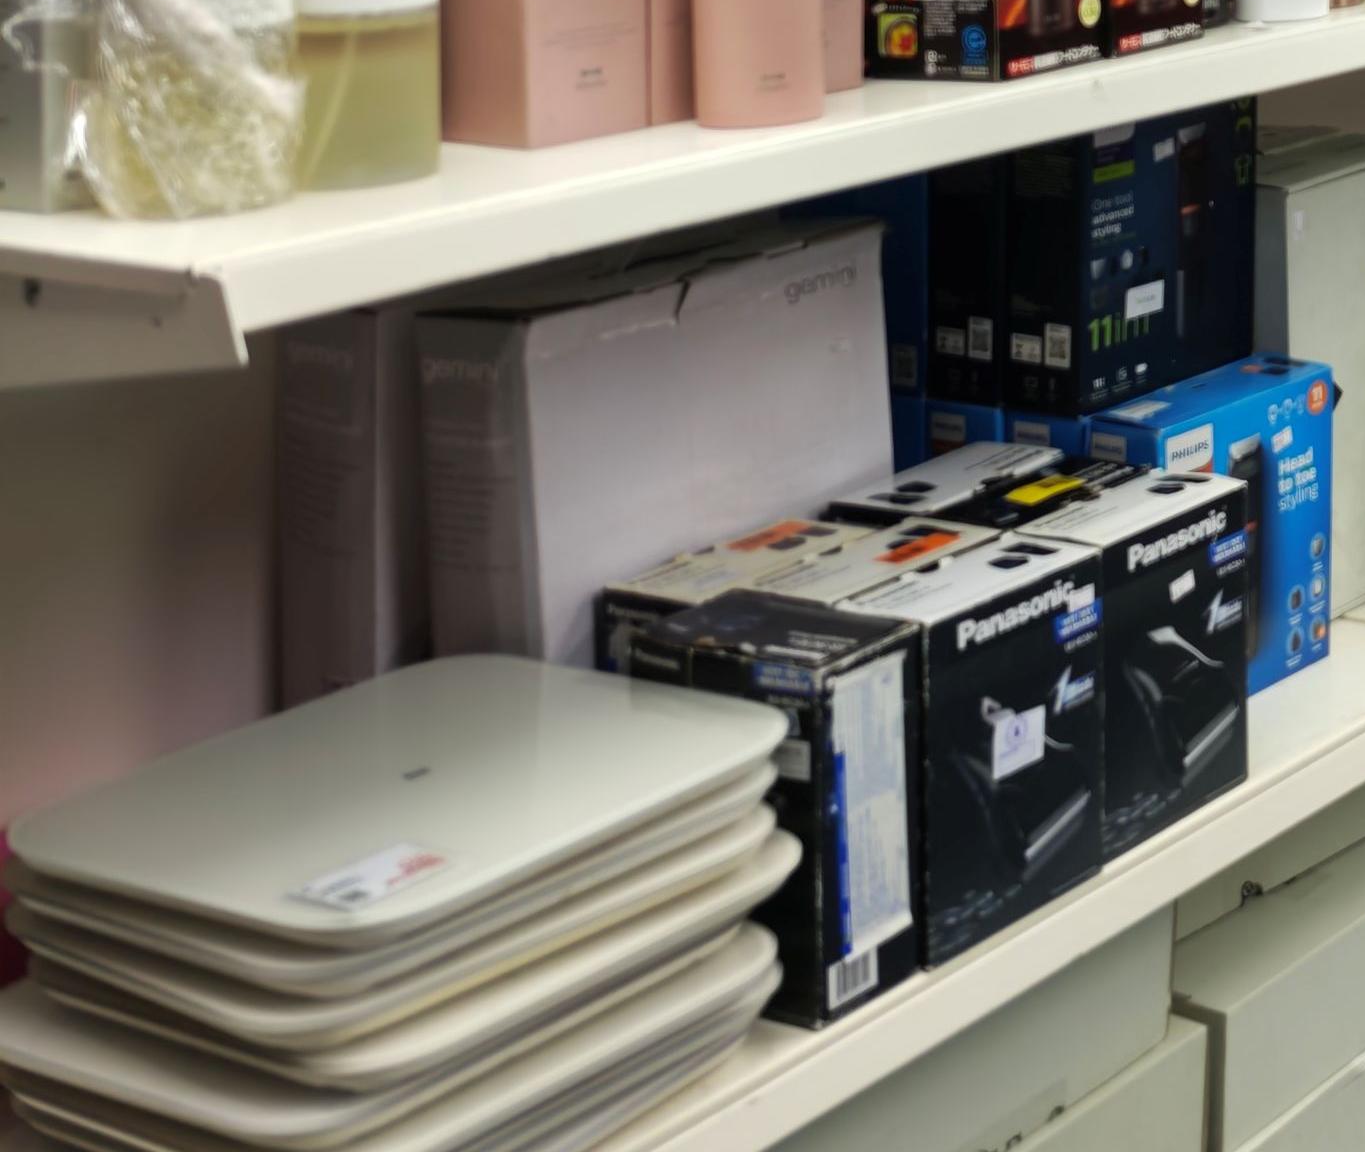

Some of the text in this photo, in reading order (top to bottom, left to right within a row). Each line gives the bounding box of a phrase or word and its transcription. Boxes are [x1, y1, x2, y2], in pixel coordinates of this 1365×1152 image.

[1091, 205, 1135, 226] advanced
[1091, 222, 1122, 239] styling
[784, 264, 857, 305] gemini
[1171, 439, 1210, 462] PHILIPS
[1279, 447, 1314, 474] Head
[1278, 467, 1317, 495] to toe
[1278, 483, 1319, 512] styling
[1127, 509, 1227, 572] Panasonic
[957, 577, 1075, 650] Panasonic
